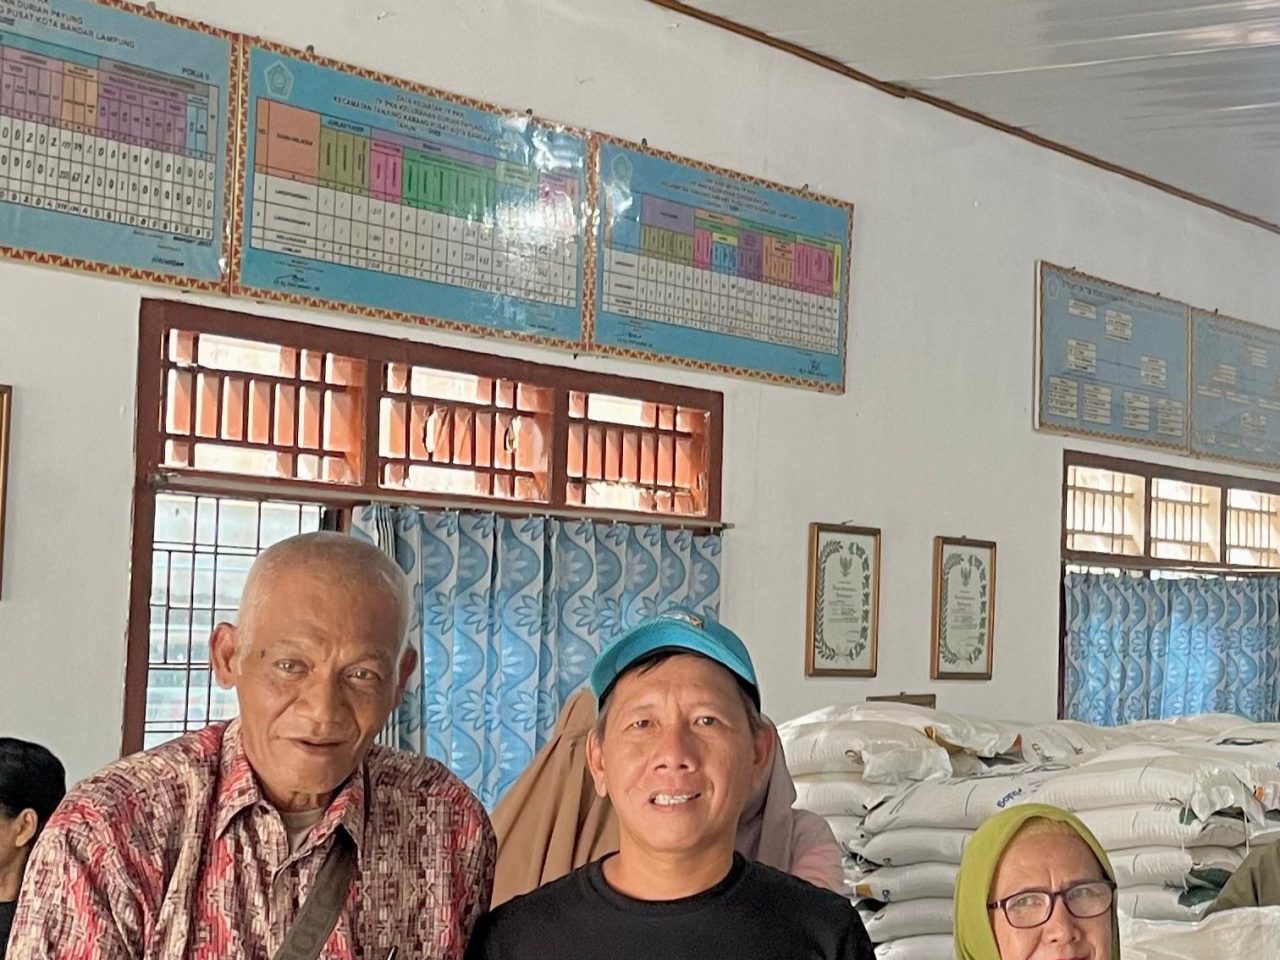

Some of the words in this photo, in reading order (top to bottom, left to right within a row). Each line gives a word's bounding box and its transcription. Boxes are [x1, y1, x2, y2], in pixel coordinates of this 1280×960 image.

[7, 7, 33, 20] PUSAT
[36, 16, 58, 28] KOTA
[60, 22, 94, 39] BANDAR
[96, 32, 135, 49] LAMPUNG
